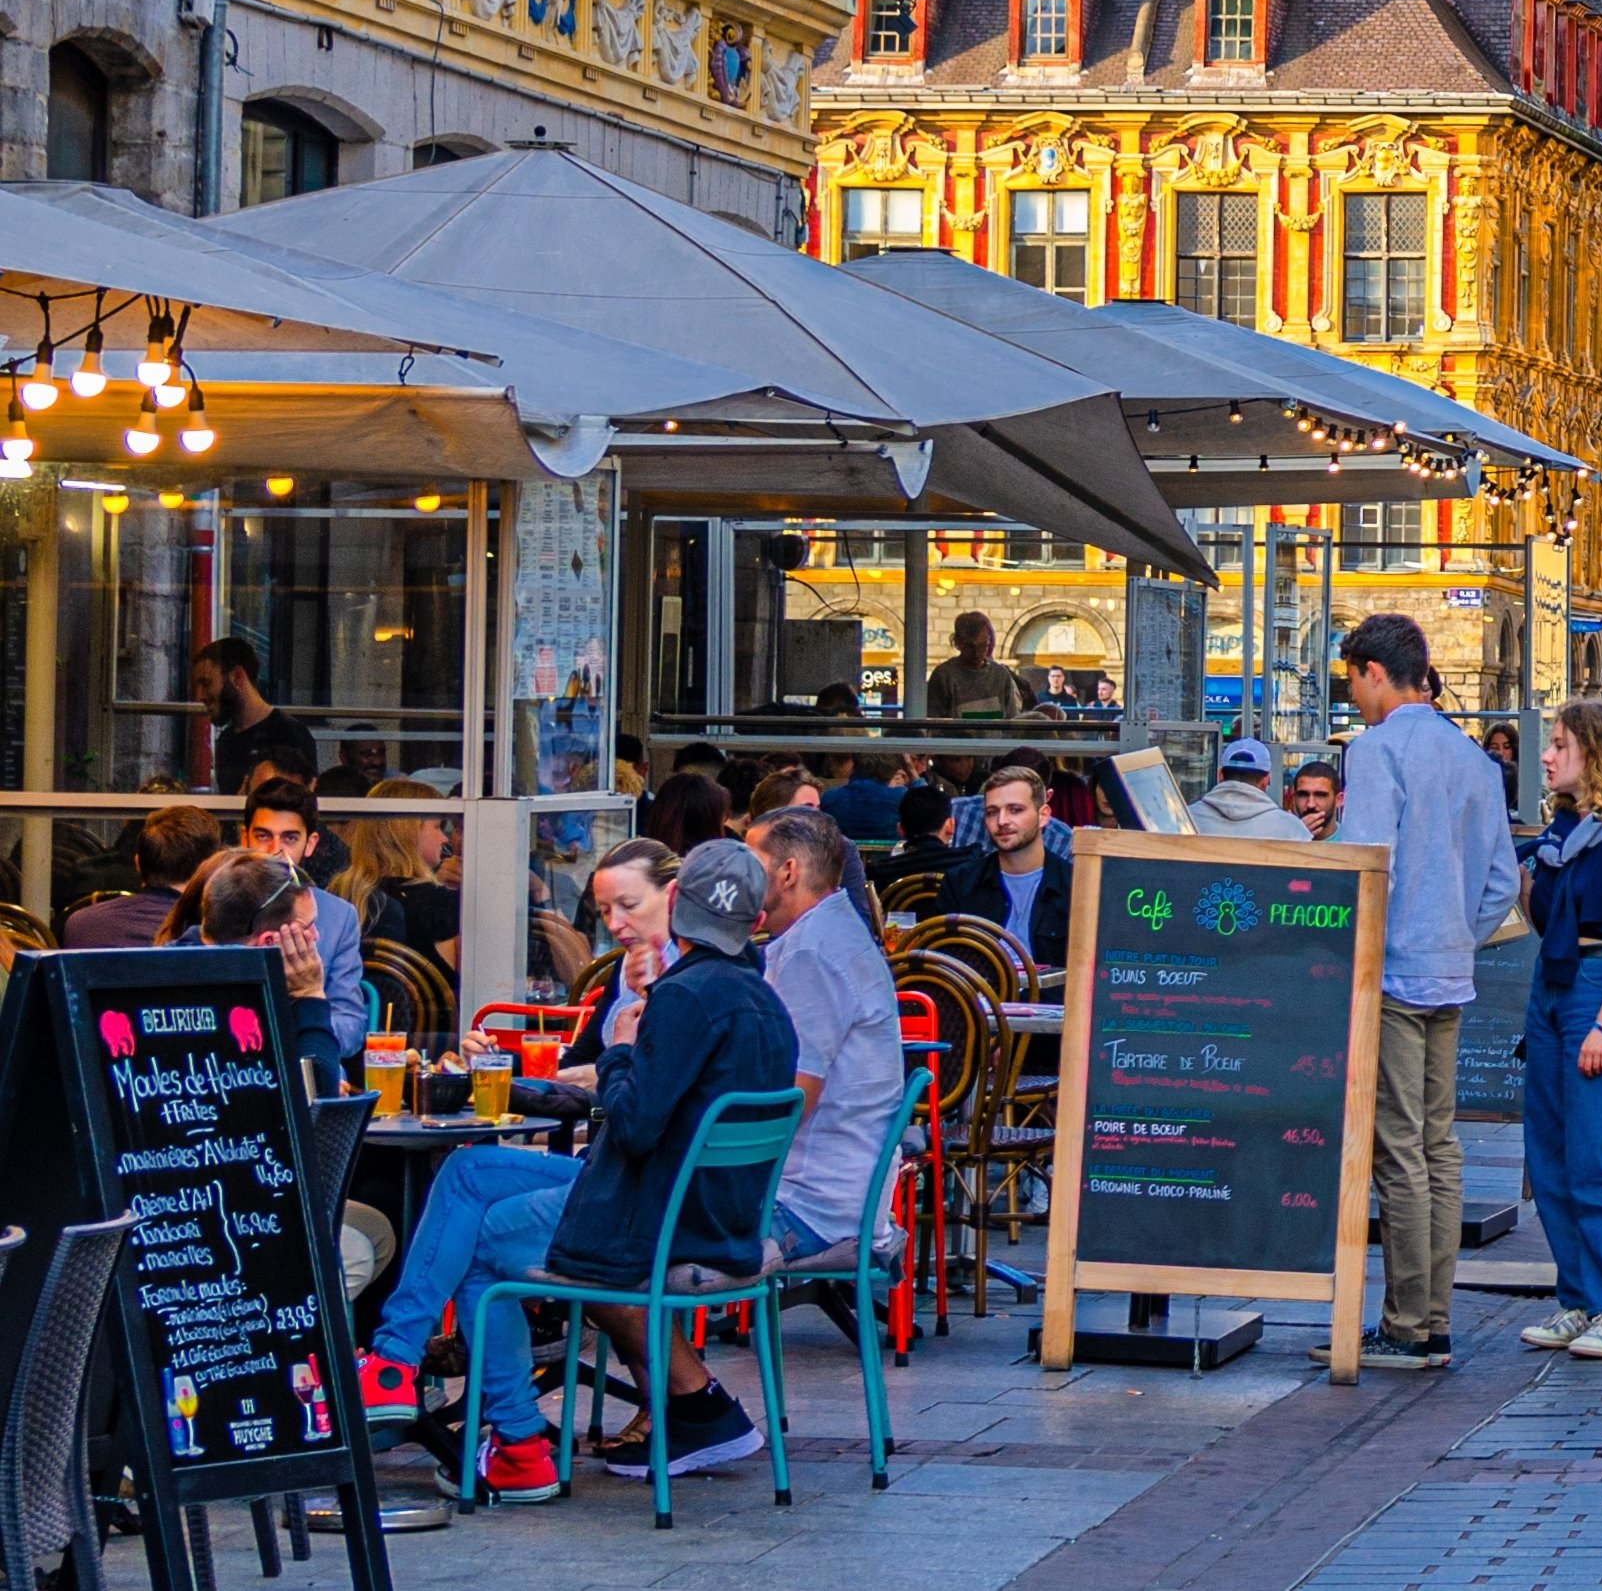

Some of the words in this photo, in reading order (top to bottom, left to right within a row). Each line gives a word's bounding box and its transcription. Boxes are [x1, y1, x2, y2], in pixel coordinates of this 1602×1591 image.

[1126, 888, 1174, 931] Café
[1269, 903, 1352, 929] PEACOCK
[1105, 950, 1139, 962] NOTRE
[1110, 967, 1146, 985] BUNS
[141, 1008, 217, 1033] DELIRIUM
[1180, 1057, 1196, 1070] DE
[112, 1056, 182, 1113] Moules
[184, 1052, 209, 1095] de
[205, 1052, 278, 1105] Hollande
[1133, 1123, 1148, 1135] DE
[233, 1426, 274, 1446] HUYGHE
